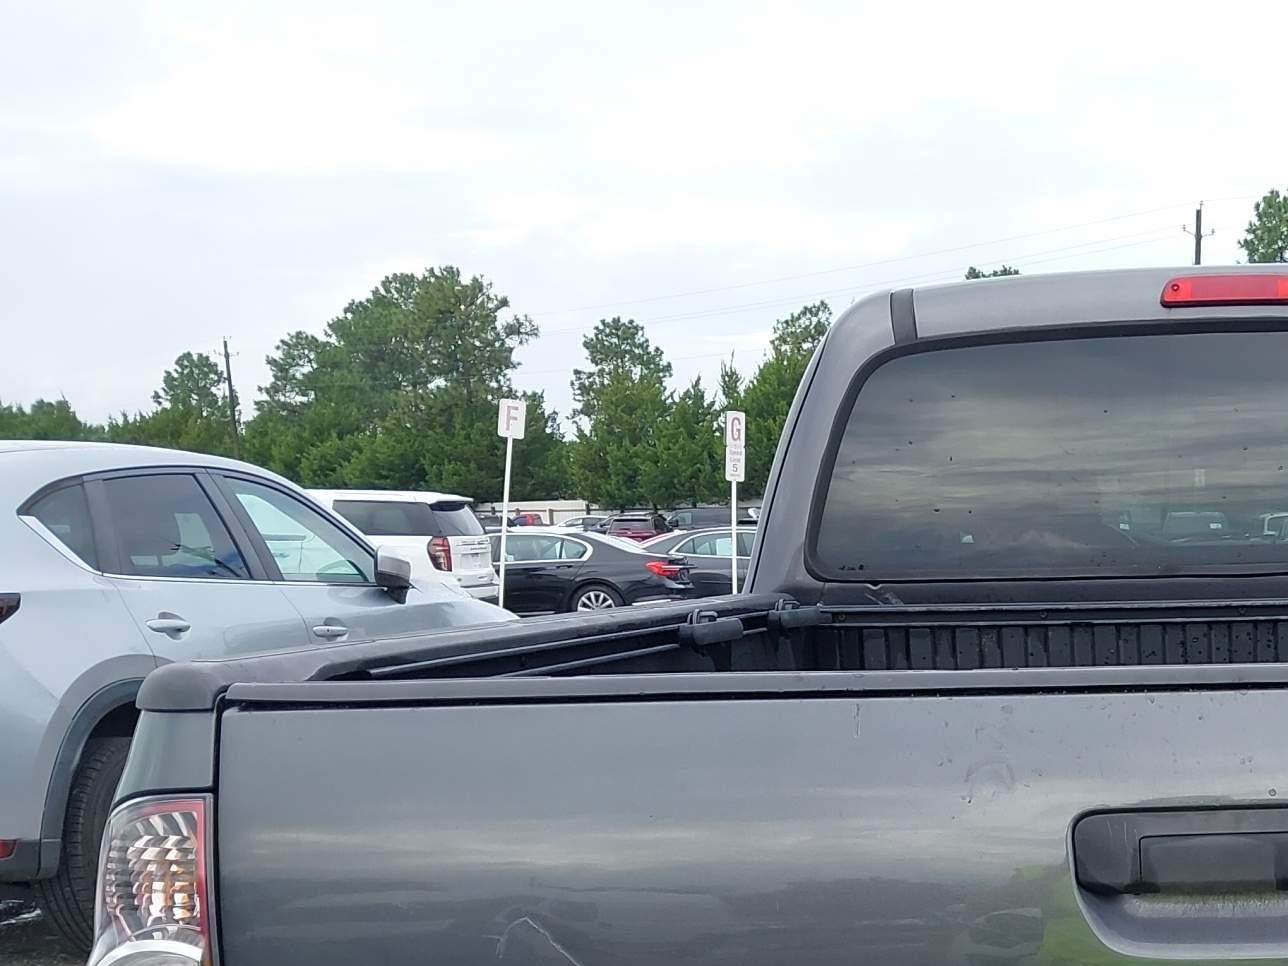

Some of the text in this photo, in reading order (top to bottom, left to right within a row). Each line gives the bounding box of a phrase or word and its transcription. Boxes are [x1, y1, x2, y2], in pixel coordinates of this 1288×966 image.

[505, 405, 520, 431] F
[731, 417, 742, 441] G
[732, 464, 739, 473] 5
